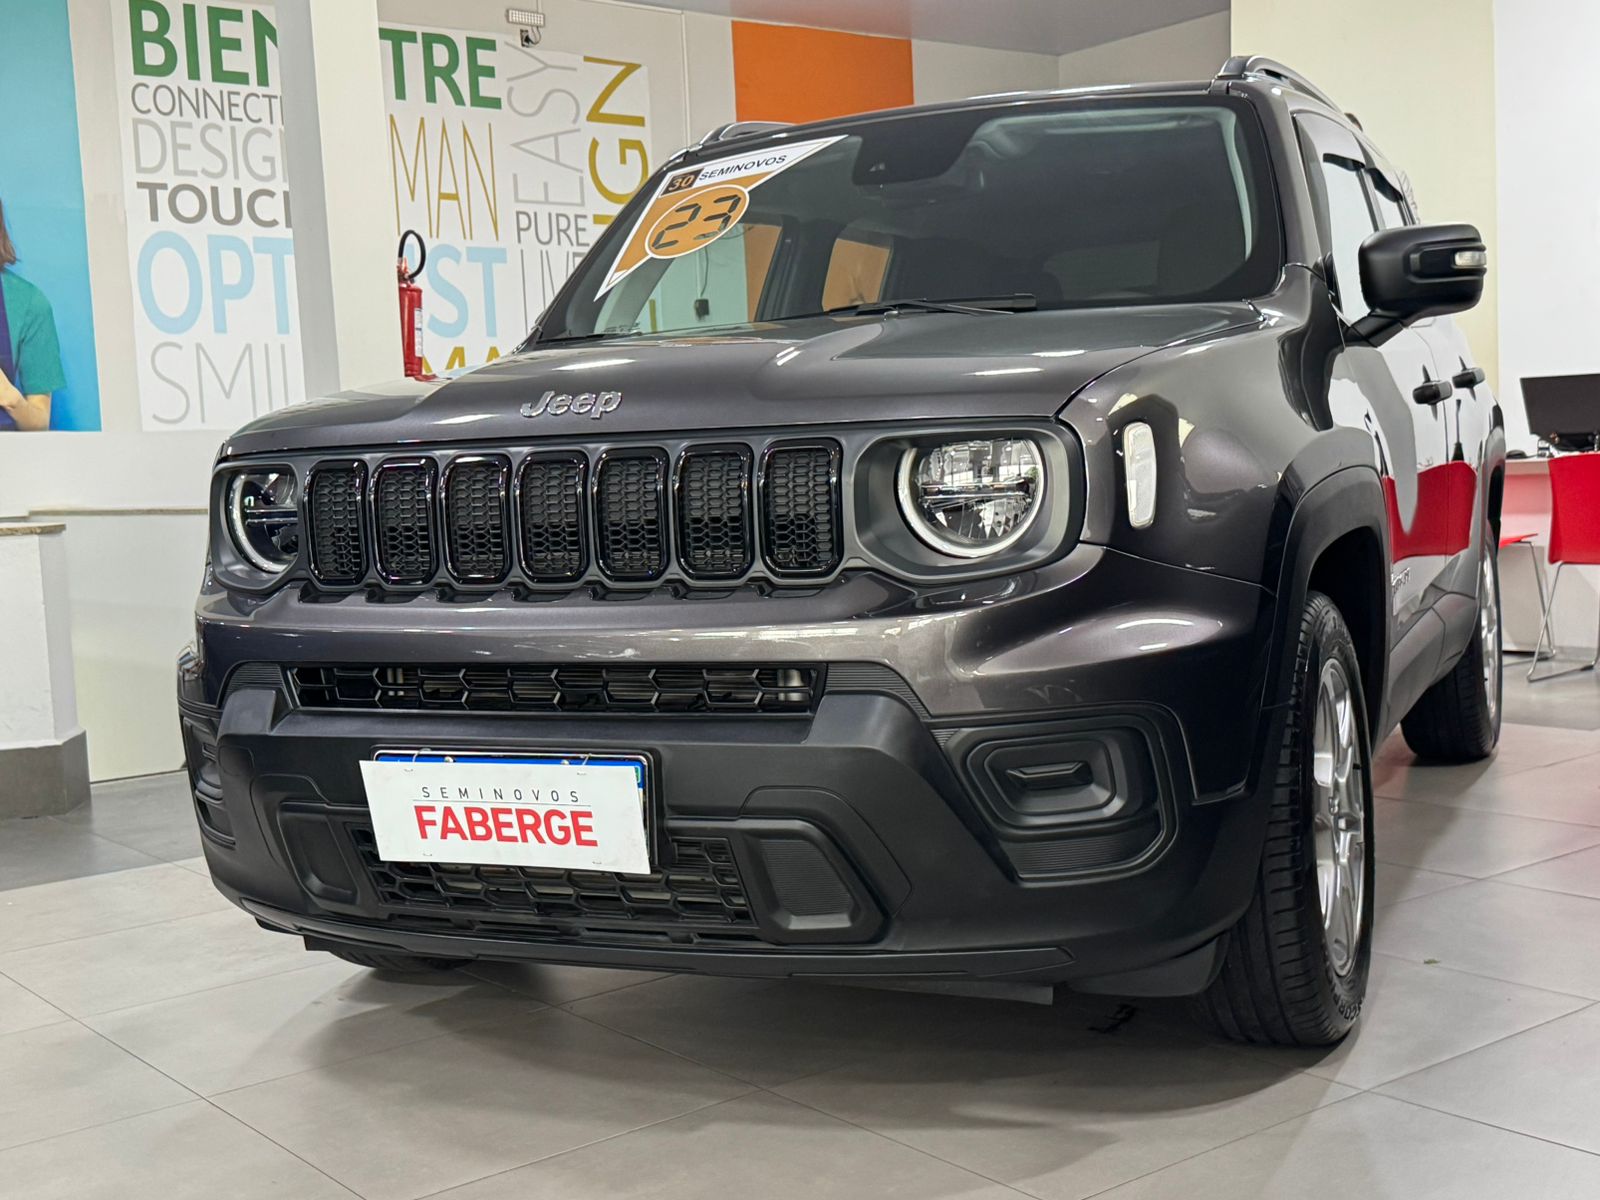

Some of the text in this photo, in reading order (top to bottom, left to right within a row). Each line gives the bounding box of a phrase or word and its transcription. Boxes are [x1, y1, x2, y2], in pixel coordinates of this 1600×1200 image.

[504, 41, 585, 207] EASY
[132, 117, 288, 183] DESIG
[698, 154, 787, 181] SEMINOVOS
[390, 113, 498, 241] MAN
[515, 211, 590, 247] PURE
[652, 194, 741, 250] 23
[137, 230, 294, 335] OPT
[520, 390, 622, 420] Jeep
[421, 786, 579, 803] SEMINOVOS
[414, 804, 598, 847] FABERGE
